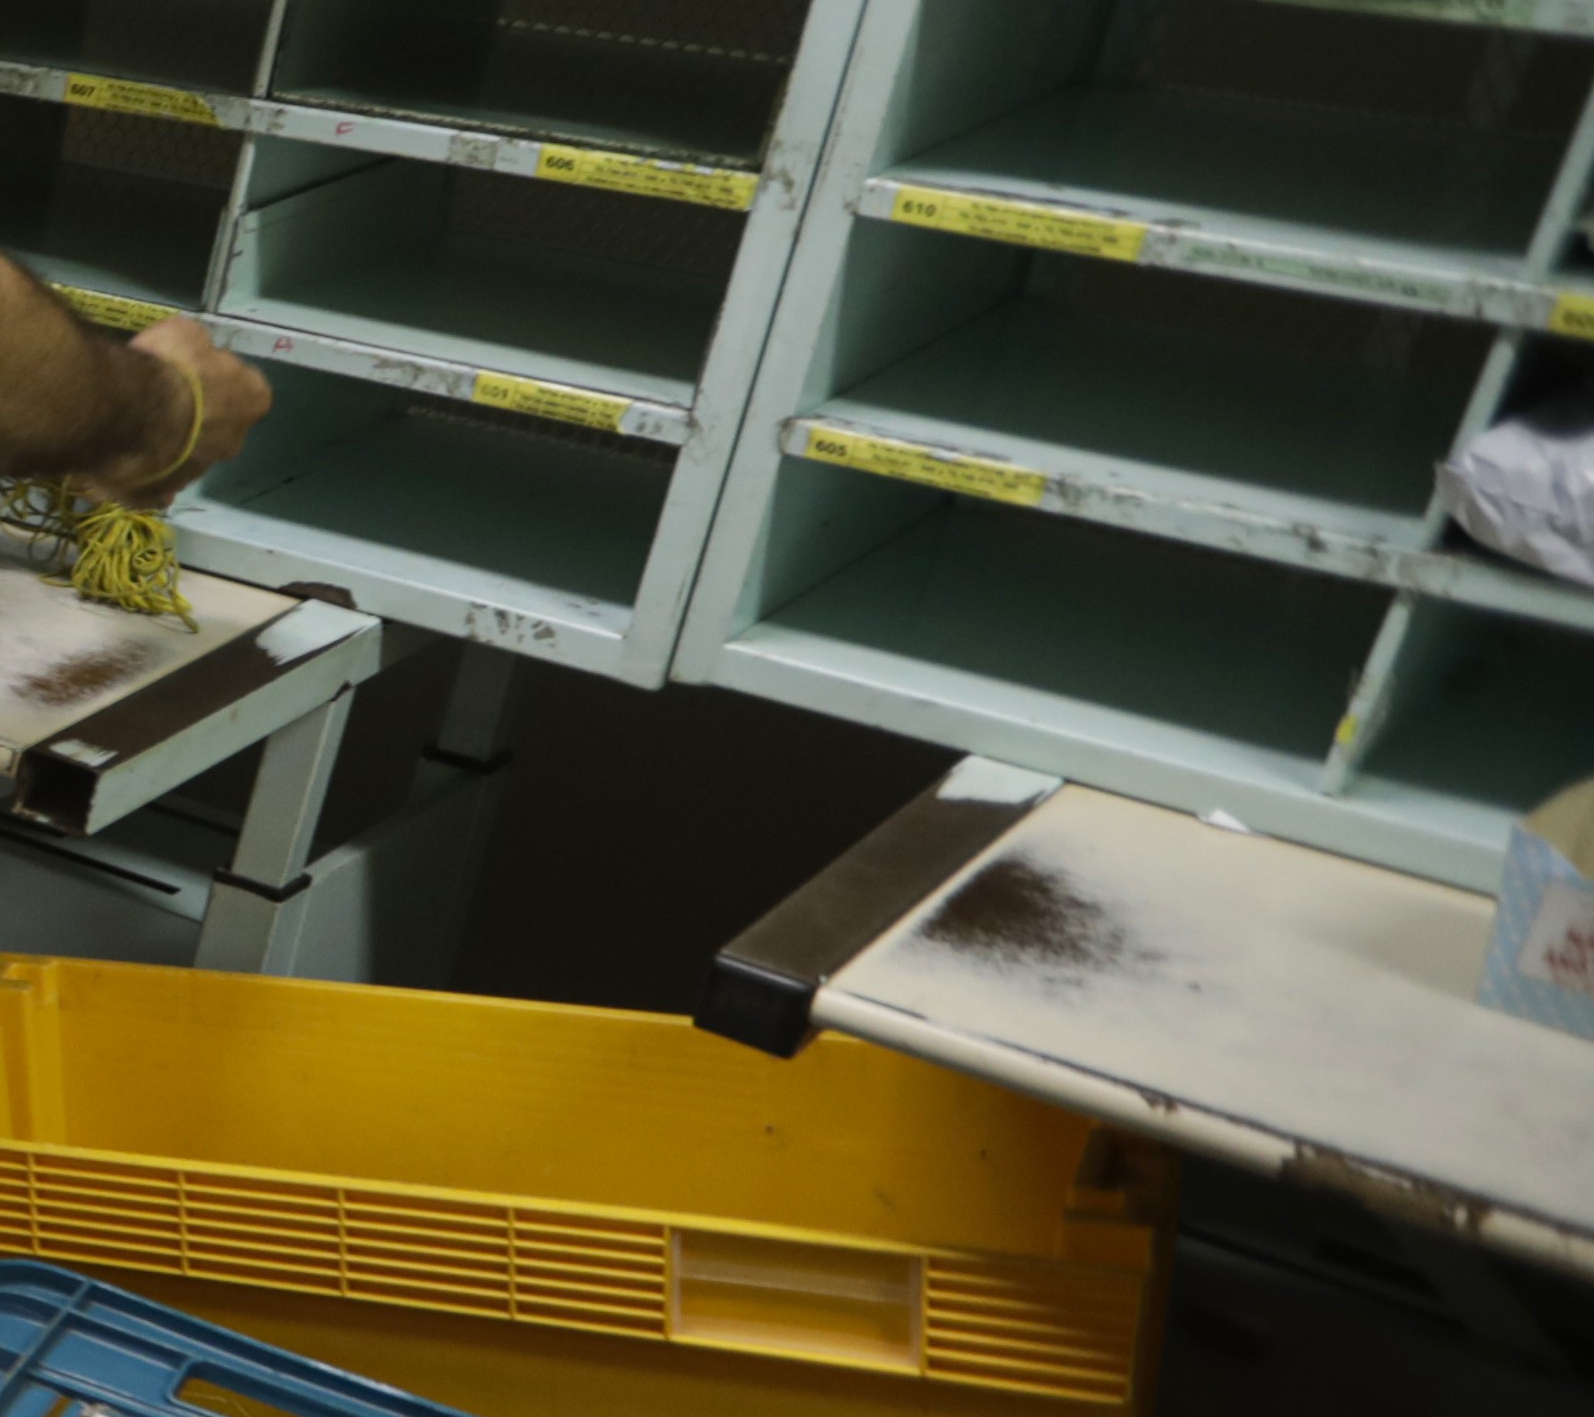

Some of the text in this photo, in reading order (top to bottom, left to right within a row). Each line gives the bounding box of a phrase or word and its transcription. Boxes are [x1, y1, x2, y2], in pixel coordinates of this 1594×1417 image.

[545, 155, 576, 171] 606
[902, 199, 937, 218] 610
[815, 440, 848, 457] 605
